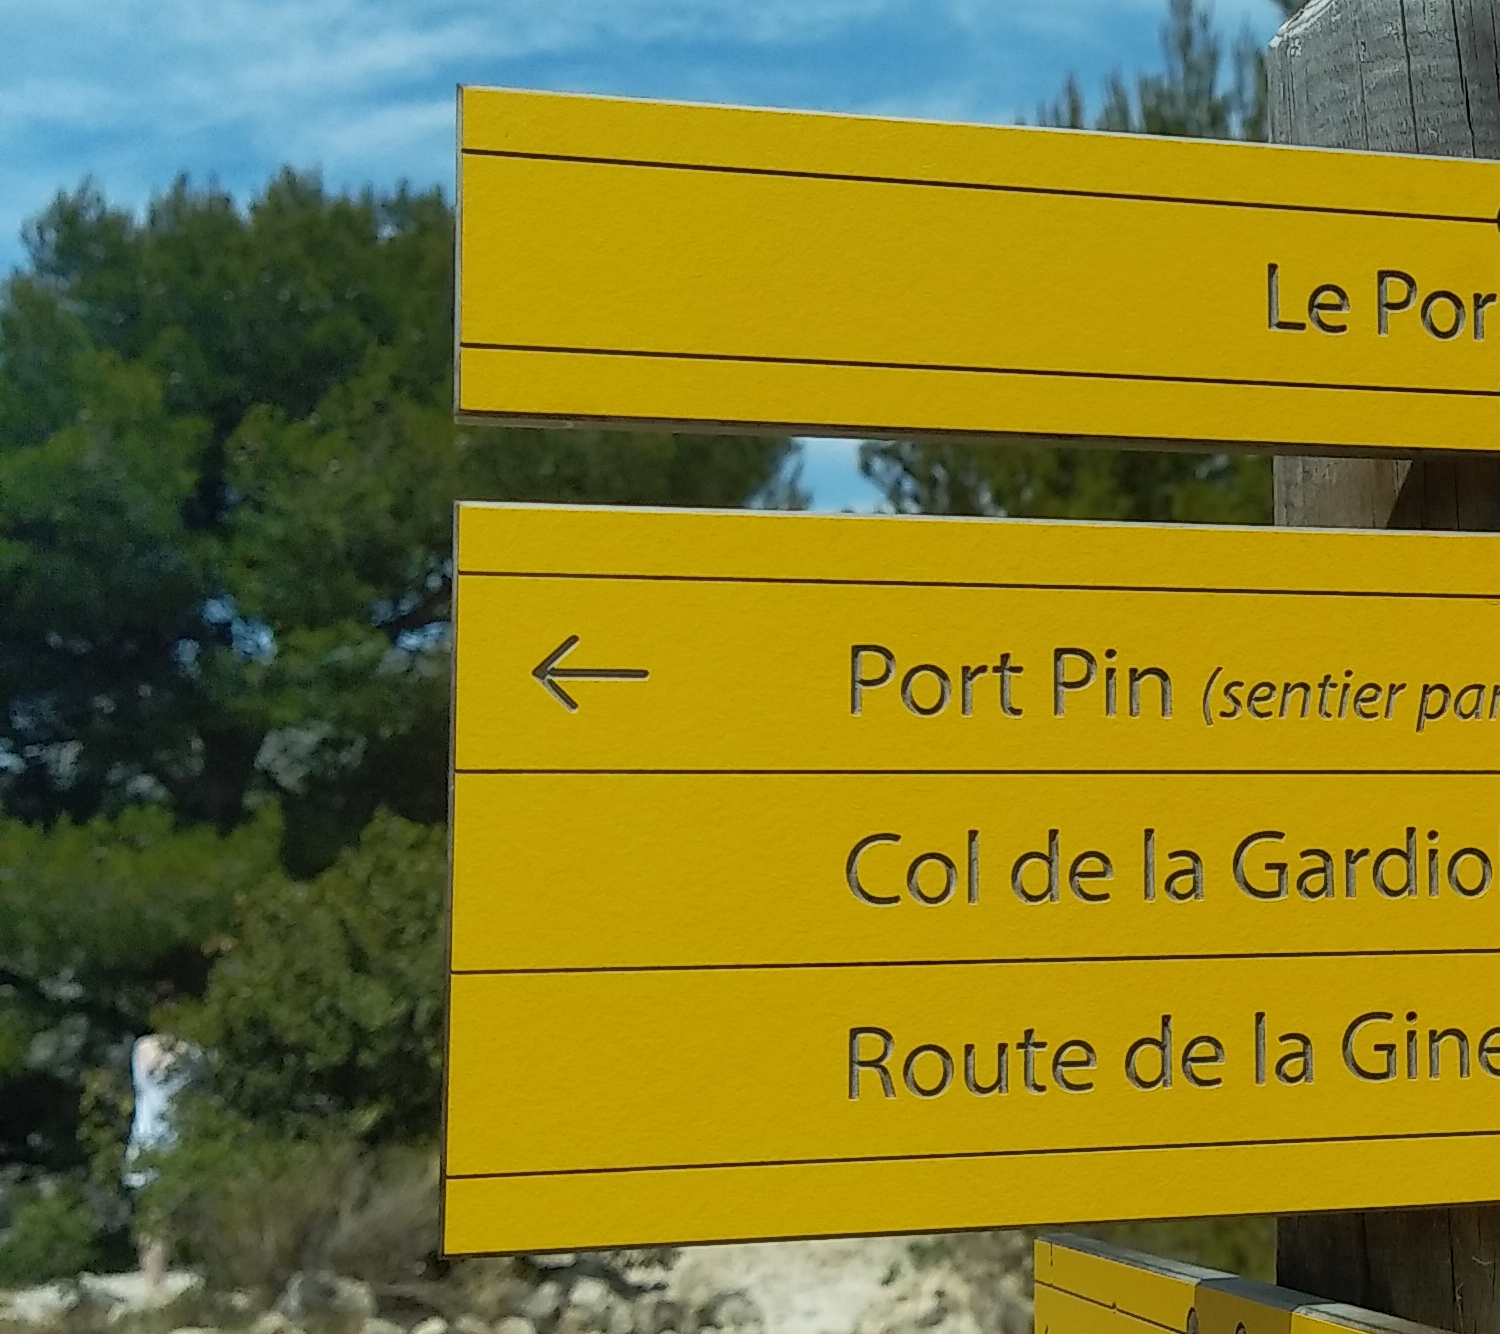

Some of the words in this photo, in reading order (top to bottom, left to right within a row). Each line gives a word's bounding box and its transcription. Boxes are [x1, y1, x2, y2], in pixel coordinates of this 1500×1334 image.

[1265, 261, 1351, 335] Le
[849, 644, 1024, 719] Port
[1052, 647, 1174, 720] Pin
[1203, 665, 1408, 727] (sentier
[845, 830, 981, 907] Col
[1010, 828, 1116, 905] de
[1142, 827, 1205, 903] la
[847, 1025, 1099, 1101] Route
[1123, 1014, 1226, 1092] de
[1254, 1012, 1317, 1086] la
